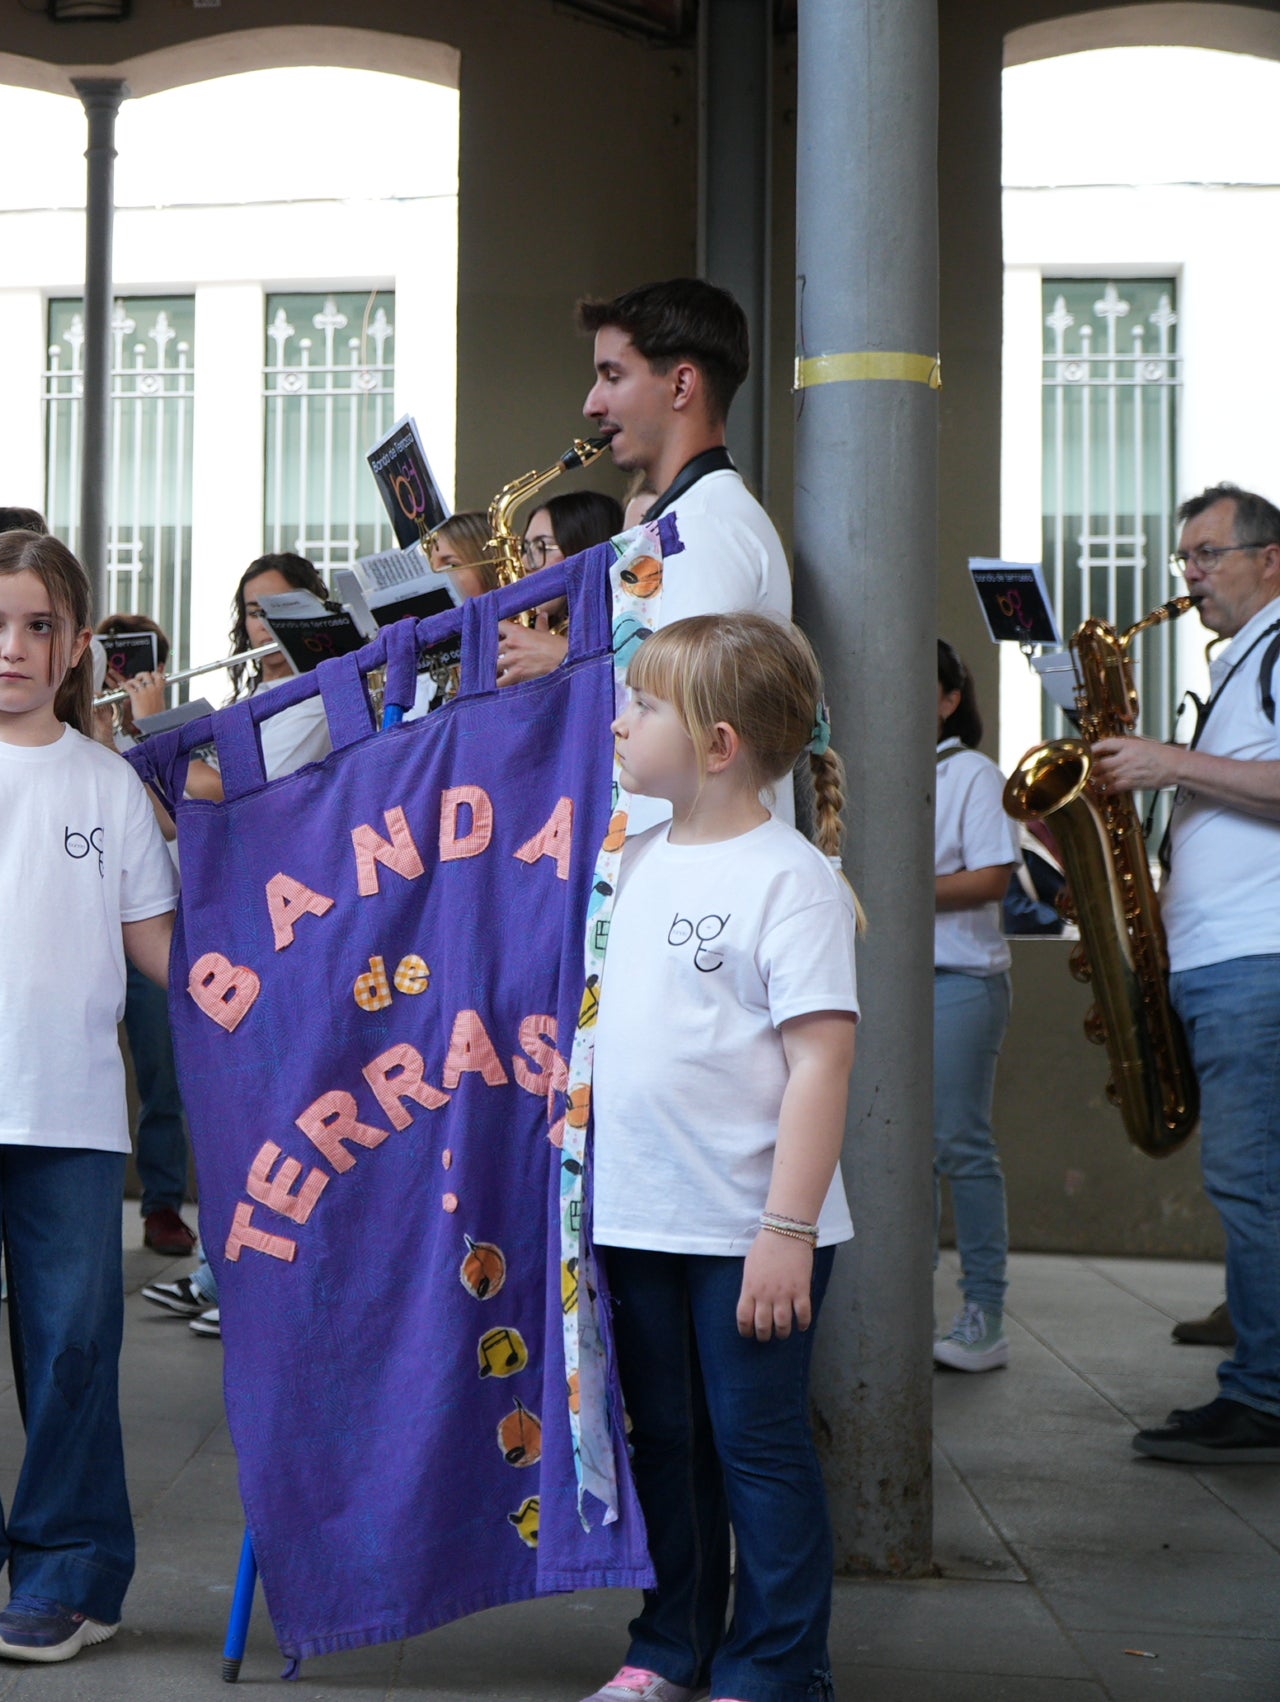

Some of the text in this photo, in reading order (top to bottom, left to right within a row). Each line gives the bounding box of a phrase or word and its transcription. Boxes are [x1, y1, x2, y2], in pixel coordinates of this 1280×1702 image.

[388, 447, 398, 460] de
[187, 784, 575, 1033] BANDA
[353, 953, 431, 1012] de
[225, 1009, 569, 1263] TERRAS
